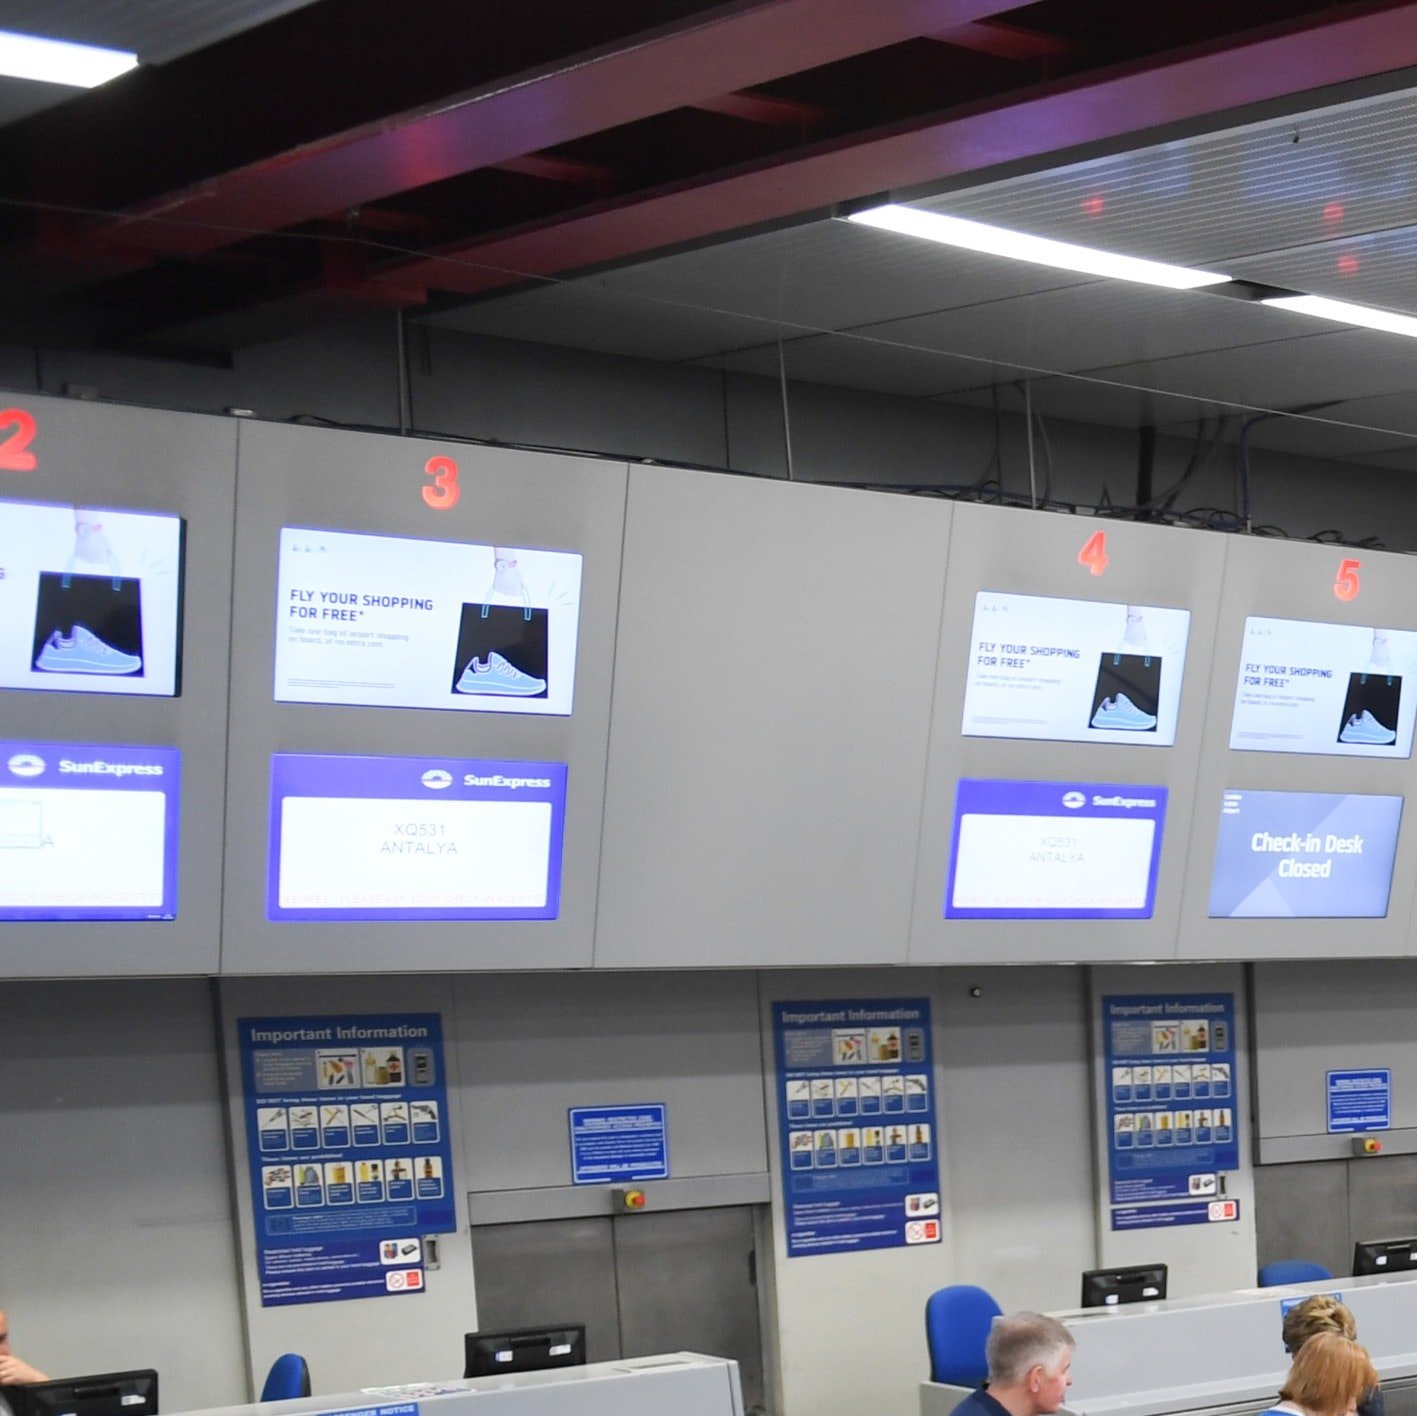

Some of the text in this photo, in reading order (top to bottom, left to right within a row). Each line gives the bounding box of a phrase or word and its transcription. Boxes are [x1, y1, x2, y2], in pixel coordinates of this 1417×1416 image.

[0, 408, 38, 472] 2
[421, 455, 460, 510] 3
[1078, 530, 1108, 576] 4
[1334, 559, 1362, 602] 5
[290, 588, 434, 612] FLY YOUR SHOPPING
[289, 605, 318, 619] FOR
[979, 641, 1081, 660] FLY YOUR SHOPPING
[977, 655, 999, 667] FOR
[1245, 663, 1333, 680] FLY YOUR SHOPPING
[1243, 675, 1261, 687] FOR
[57, 759, 165, 778] SunExpress
[463, 773, 551, 790] SunExpress
[1092, 794, 1158, 809] SunExpress
[394, 822, 446, 837] XQ531
[380, 840, 459, 855] ANTALYA
[1251, 831, 1363, 854] Check-in Desk
[1028, 851, 1085, 863] ANTALYA
[1277, 858, 1333, 879] Closed
[782, 1008, 920, 1025] Important Information
[1110, 1002, 1225, 1017] Important Information
[251, 1024, 428, 1045] Important Information
[379, 1404, 416, 1416] NOTICE
